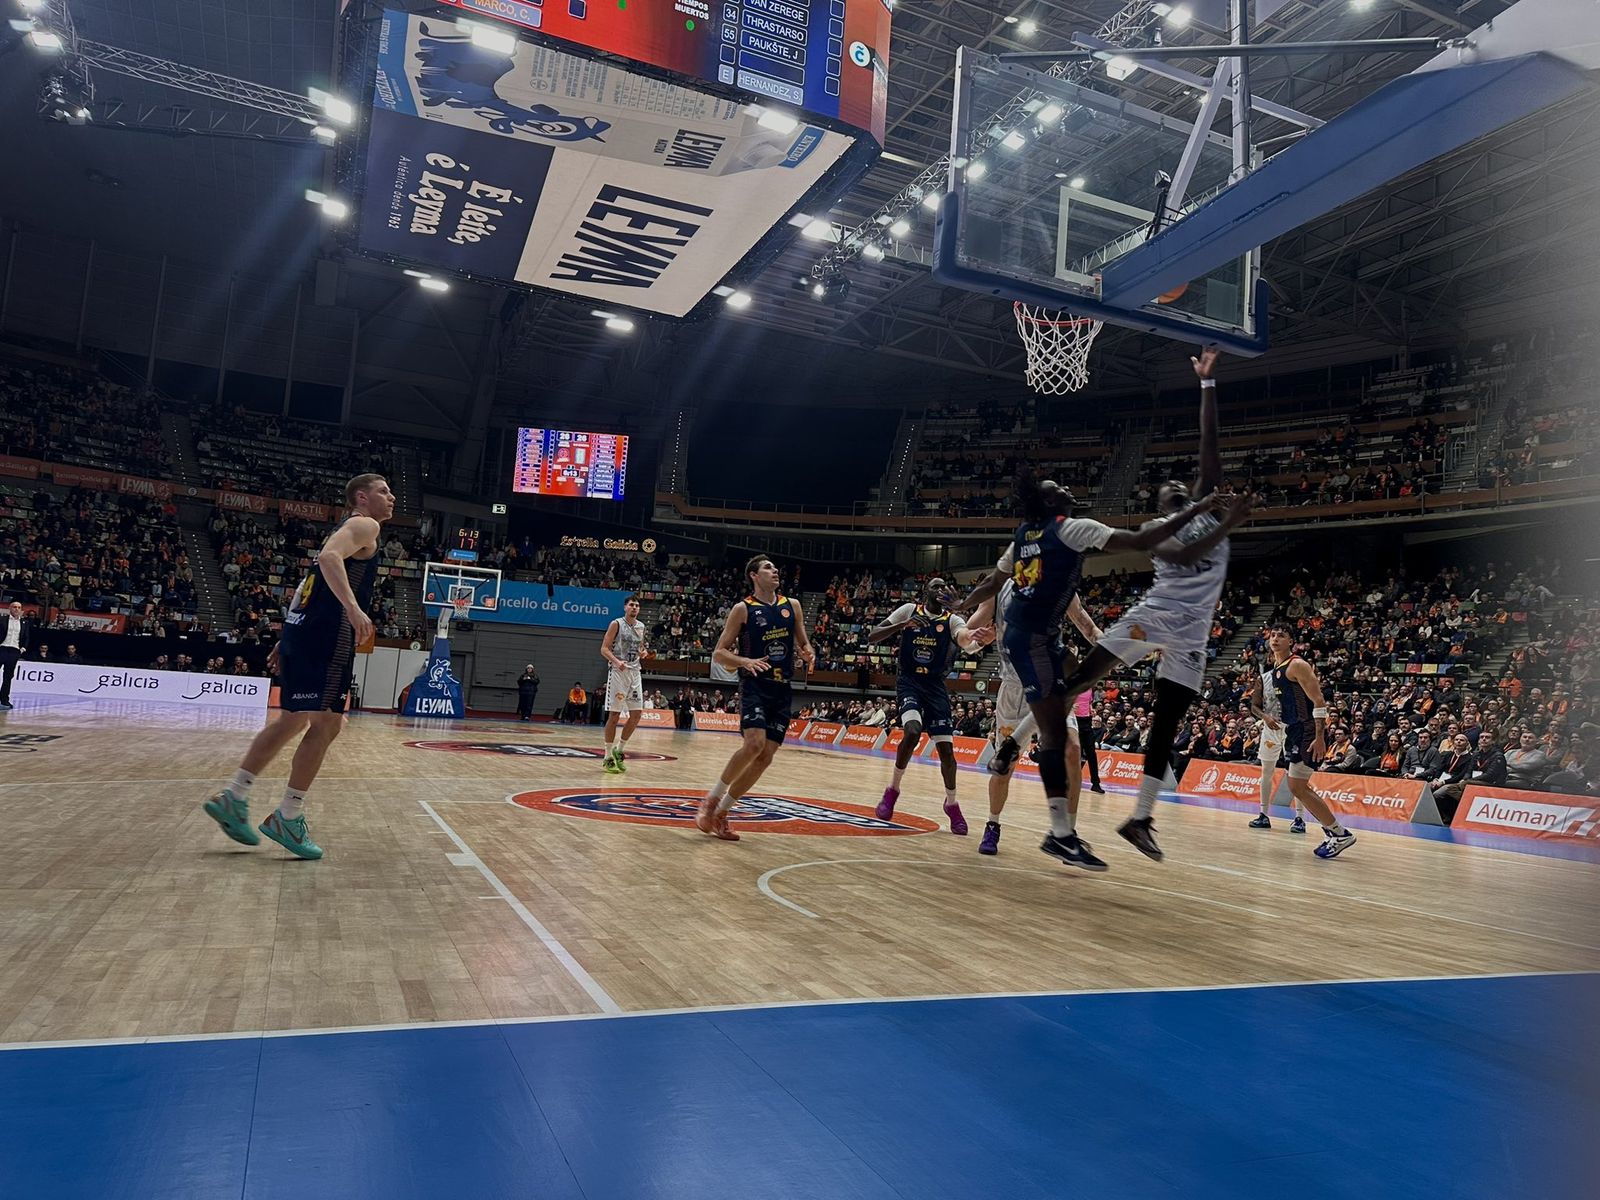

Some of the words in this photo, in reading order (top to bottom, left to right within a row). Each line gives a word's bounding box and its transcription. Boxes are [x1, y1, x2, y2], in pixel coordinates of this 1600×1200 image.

[520, 9, 531, 20] C.
[674, 3, 709, 20] MUERTOS
[725, 8, 737, 20] 34
[768, 1, 805, 21] ZEREGE
[723, 28, 735, 40] 55
[746, 14, 805, 41] THRASTARSO
[748, 36, 791, 59] PAUKŠTE,
[792, 50, 799, 60] J
[722, 69, 729, 80] E
[739, 72, 791, 99] HERNANDEZ,
[663, 128, 726, 170] LEYMA
[425, 152, 470, 172] é
[466, 180, 524, 204] É
[408, 170, 464, 235] Leyma
[447, 201, 503, 245] leite,
[549, 183, 714, 289] LEYMA
[120, 477, 156, 497] LEYMA
[218, 492, 252, 511] LEYMA
[284, 502, 325, 516] MASTIL
[560, 535, 600, 549] Estrella
[603, 537, 639, 551] Galicia
[480, 593, 538, 610] Cncello
[541, 599, 558, 611] da
[562, 600, 609, 616] Coruña
[98, 672, 159, 689] galicia
[200, 679, 258, 696] galicia
[415, 697, 455, 715] LEYMA
[1112, 768, 1140, 779] Coruña
[1223, 772, 1263, 785] Básquet
[1219, 782, 1255, 795] Coruña
[1312, 787, 1357, 803] ordés
[1362, 793, 1406, 809] ancín
[1475, 803, 1558, 826] Aluman
